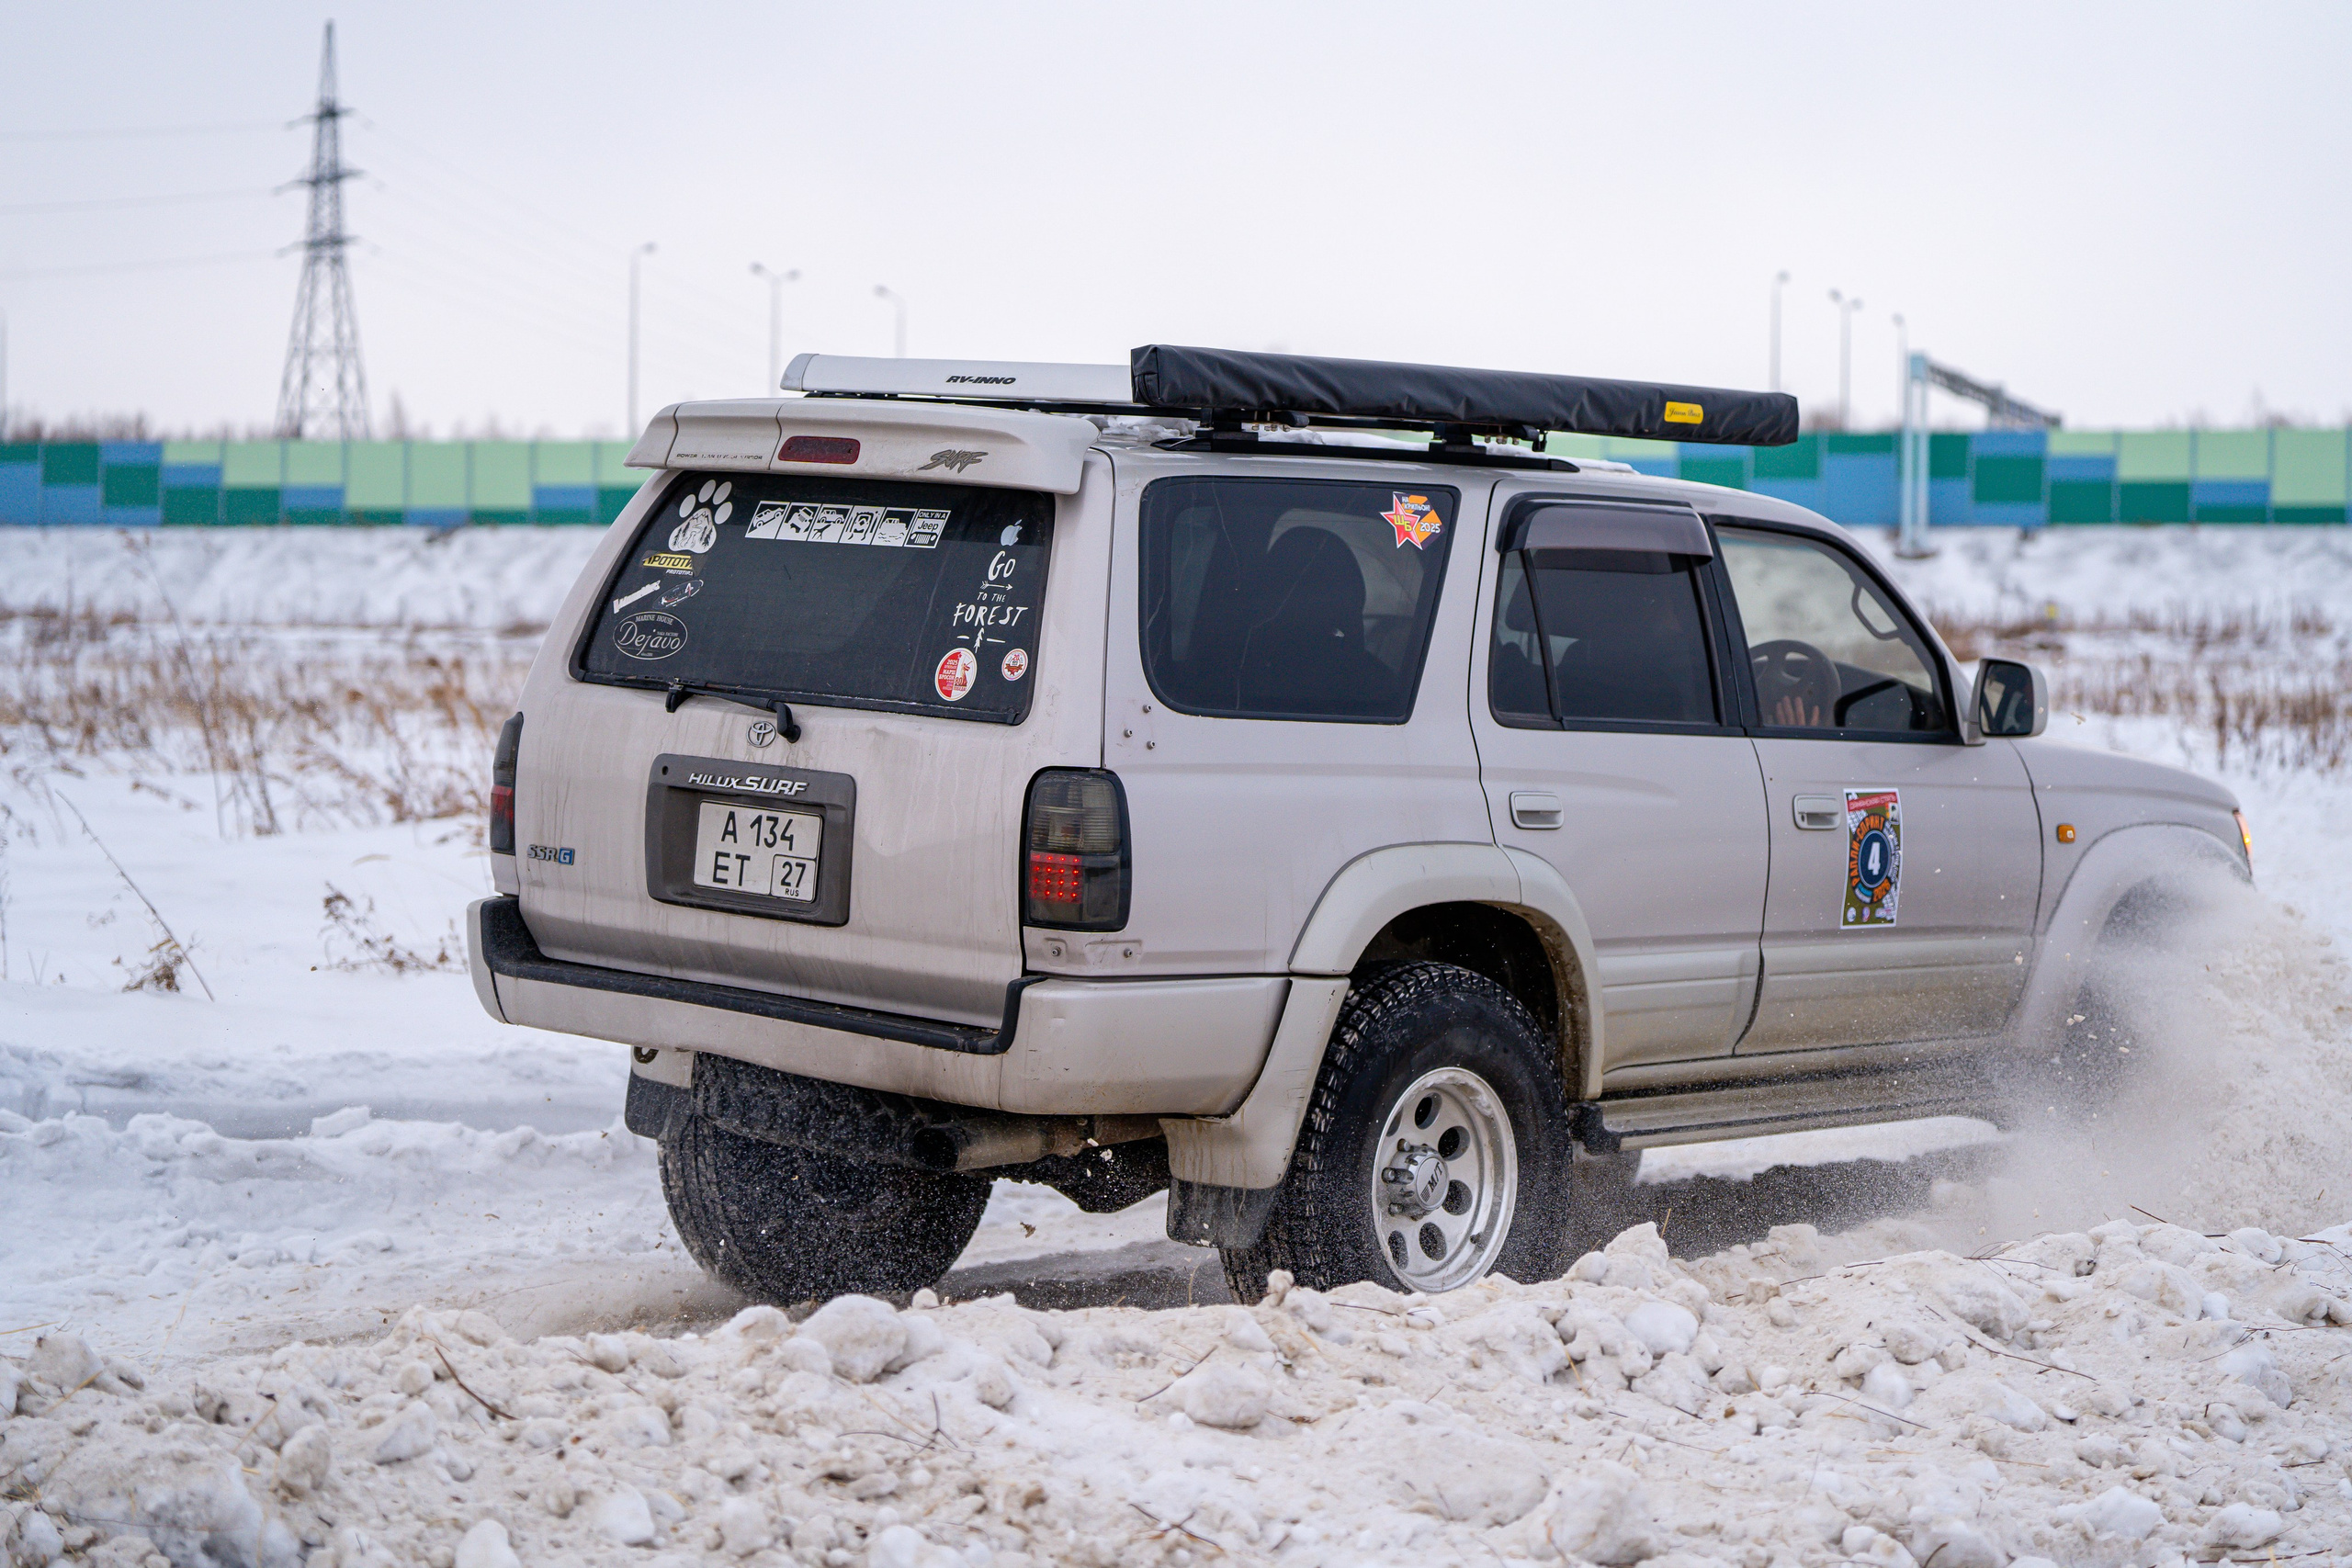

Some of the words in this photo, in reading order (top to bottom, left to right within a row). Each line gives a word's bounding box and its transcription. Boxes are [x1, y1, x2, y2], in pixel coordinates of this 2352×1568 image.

[945, 375, 1016, 385] RV-INNO
[918, 449, 989, 473] SURF
[918, 521, 939, 532] Jeep
[1419, 522, 1441, 534] 2025
[977, 592, 988, 601] TO
[991, 592, 1007, 603] THE
[656, 615, 674, 626] HOUSE
[953, 603, 1028, 626] FOREST
[688, 773, 740, 789] HILUX
[736, 775, 809, 795] SURF
[749, 815, 794, 852] 134
[527, 844, 558, 862] SSR
[1867, 841, 1882, 876] 4
[780, 861, 807, 888] 27
[785, 887, 799, 897] RUS
[1428, 1161, 1442, 1193] M/T
